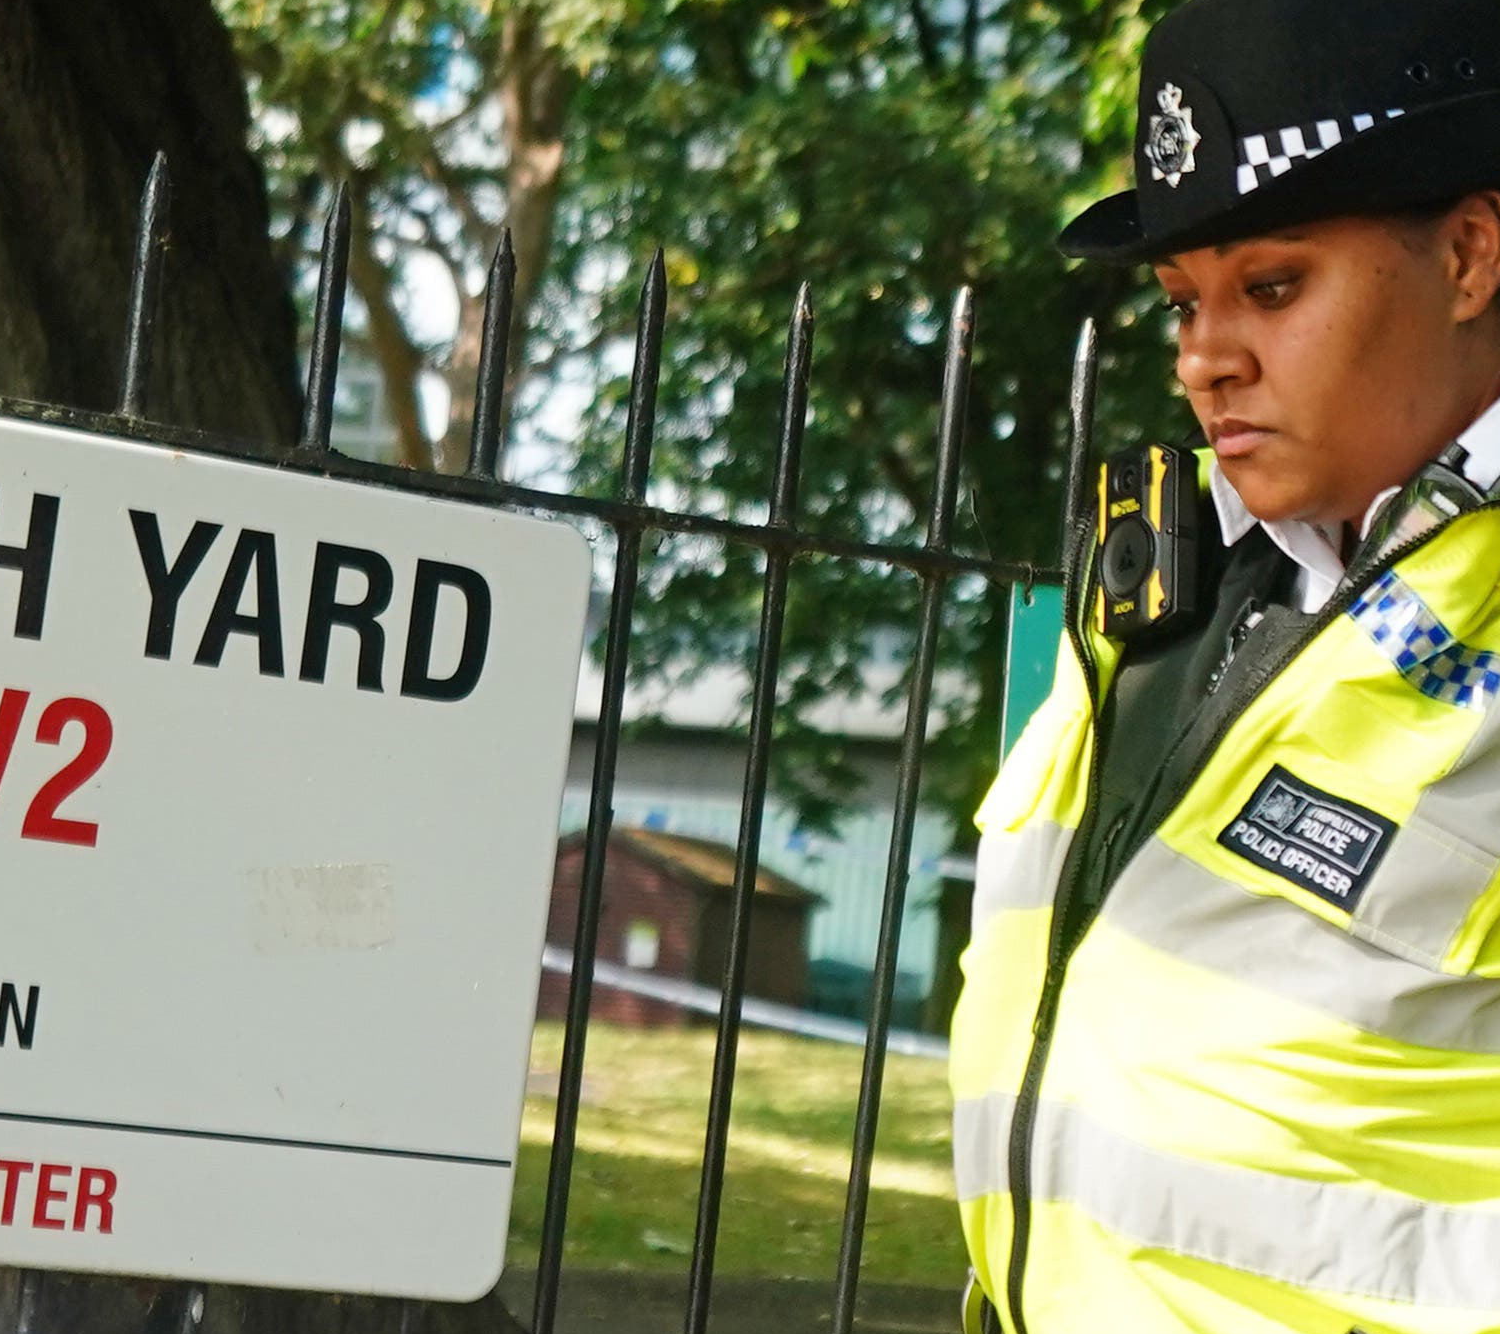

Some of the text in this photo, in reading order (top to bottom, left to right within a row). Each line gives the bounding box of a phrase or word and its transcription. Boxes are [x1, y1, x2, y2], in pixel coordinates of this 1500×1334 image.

[128, 509, 493, 704] YARD
[1294, 817, 1352, 857] POLICE
[1279, 844, 1353, 898] OFFICER
